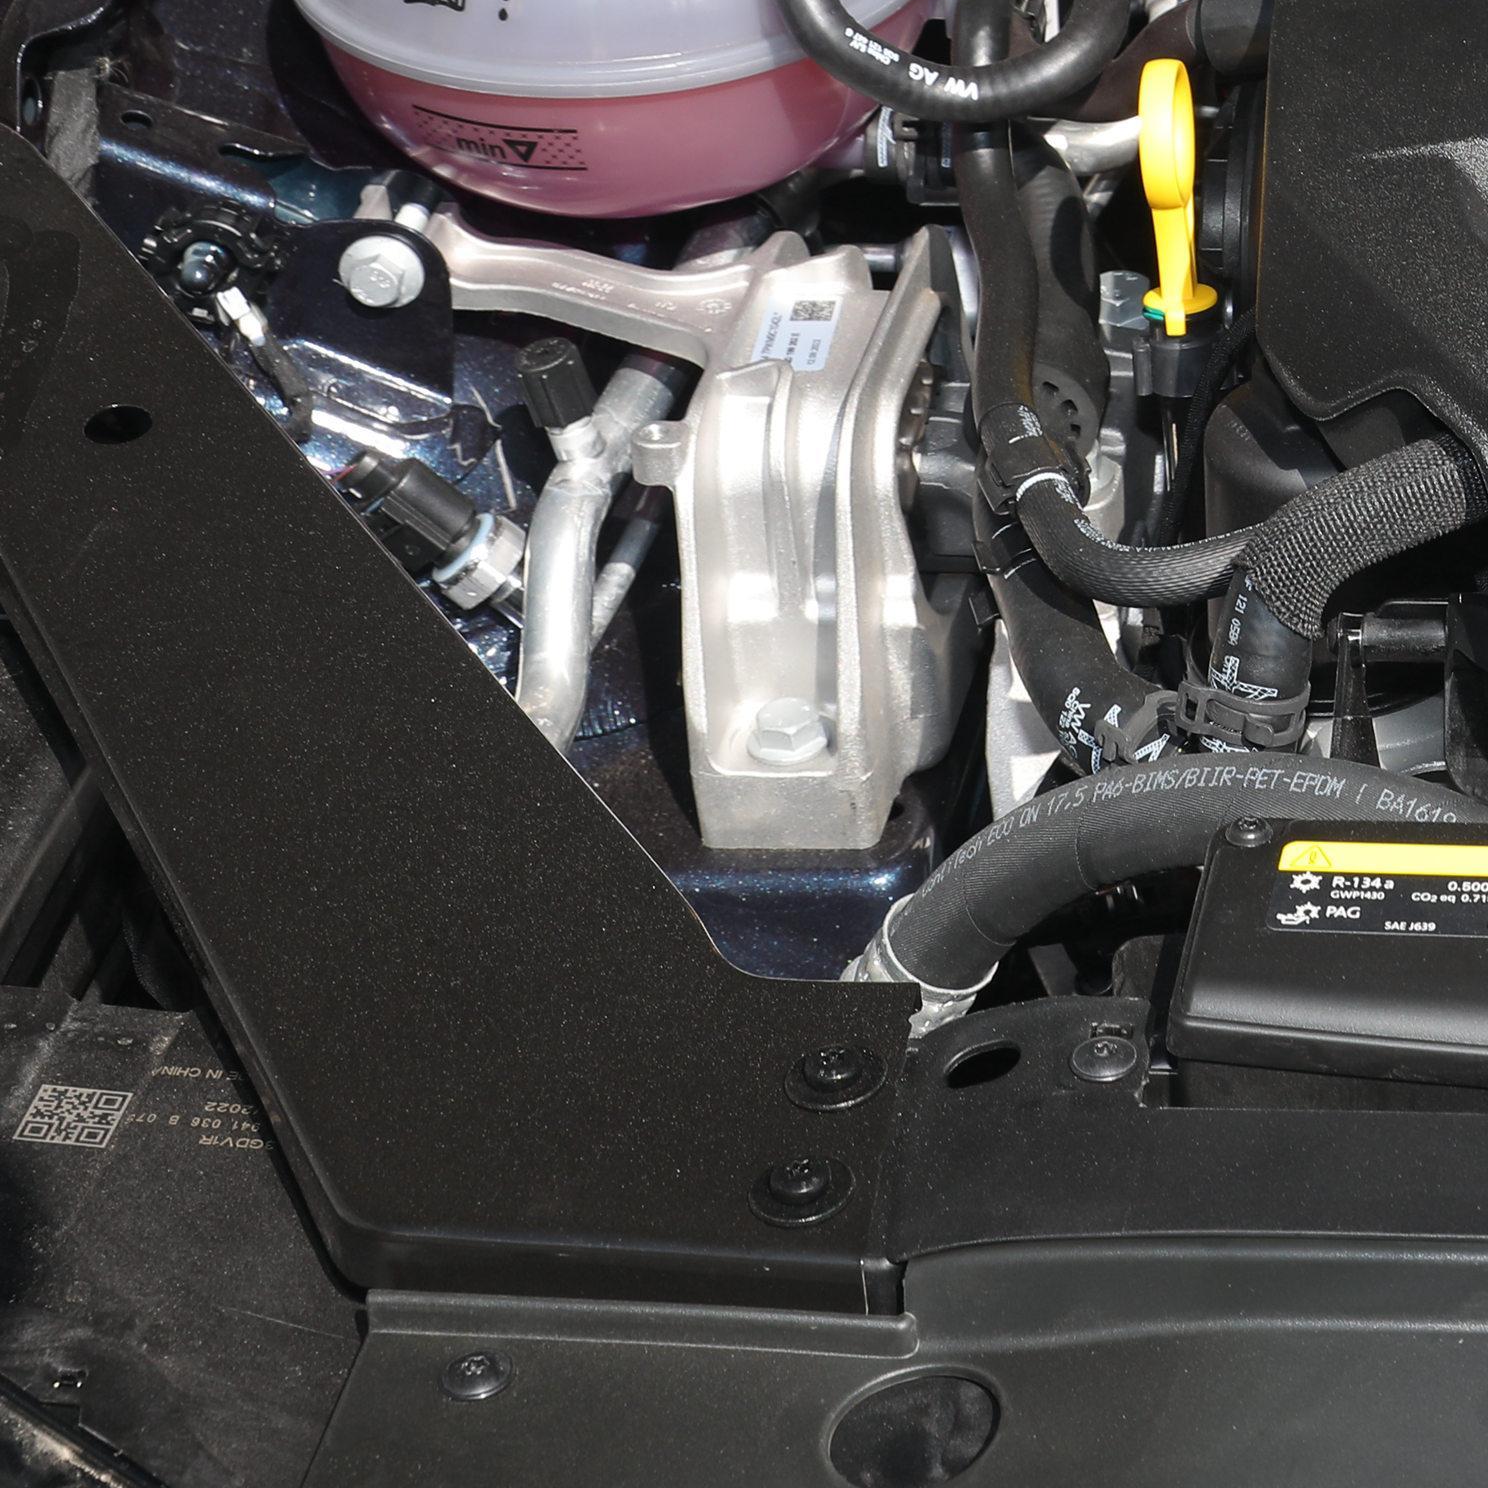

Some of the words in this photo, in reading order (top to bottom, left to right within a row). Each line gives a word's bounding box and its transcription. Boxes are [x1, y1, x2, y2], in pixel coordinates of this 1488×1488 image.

[908, 62, 939, 86] AG
[944, 77, 978, 100] VW
[457, 136, 507, 161] min
[1235, 594, 1247, 614] 121
[1330, 890, 1385, 902] GWP1430
[1440, 894, 1456, 905] eq
[1325, 906, 1361, 919] PAG
[1384, 921, 1406, 931] SAE
[1408, 921, 1436, 932] J639
[206, 1069, 223, 1079] IN
